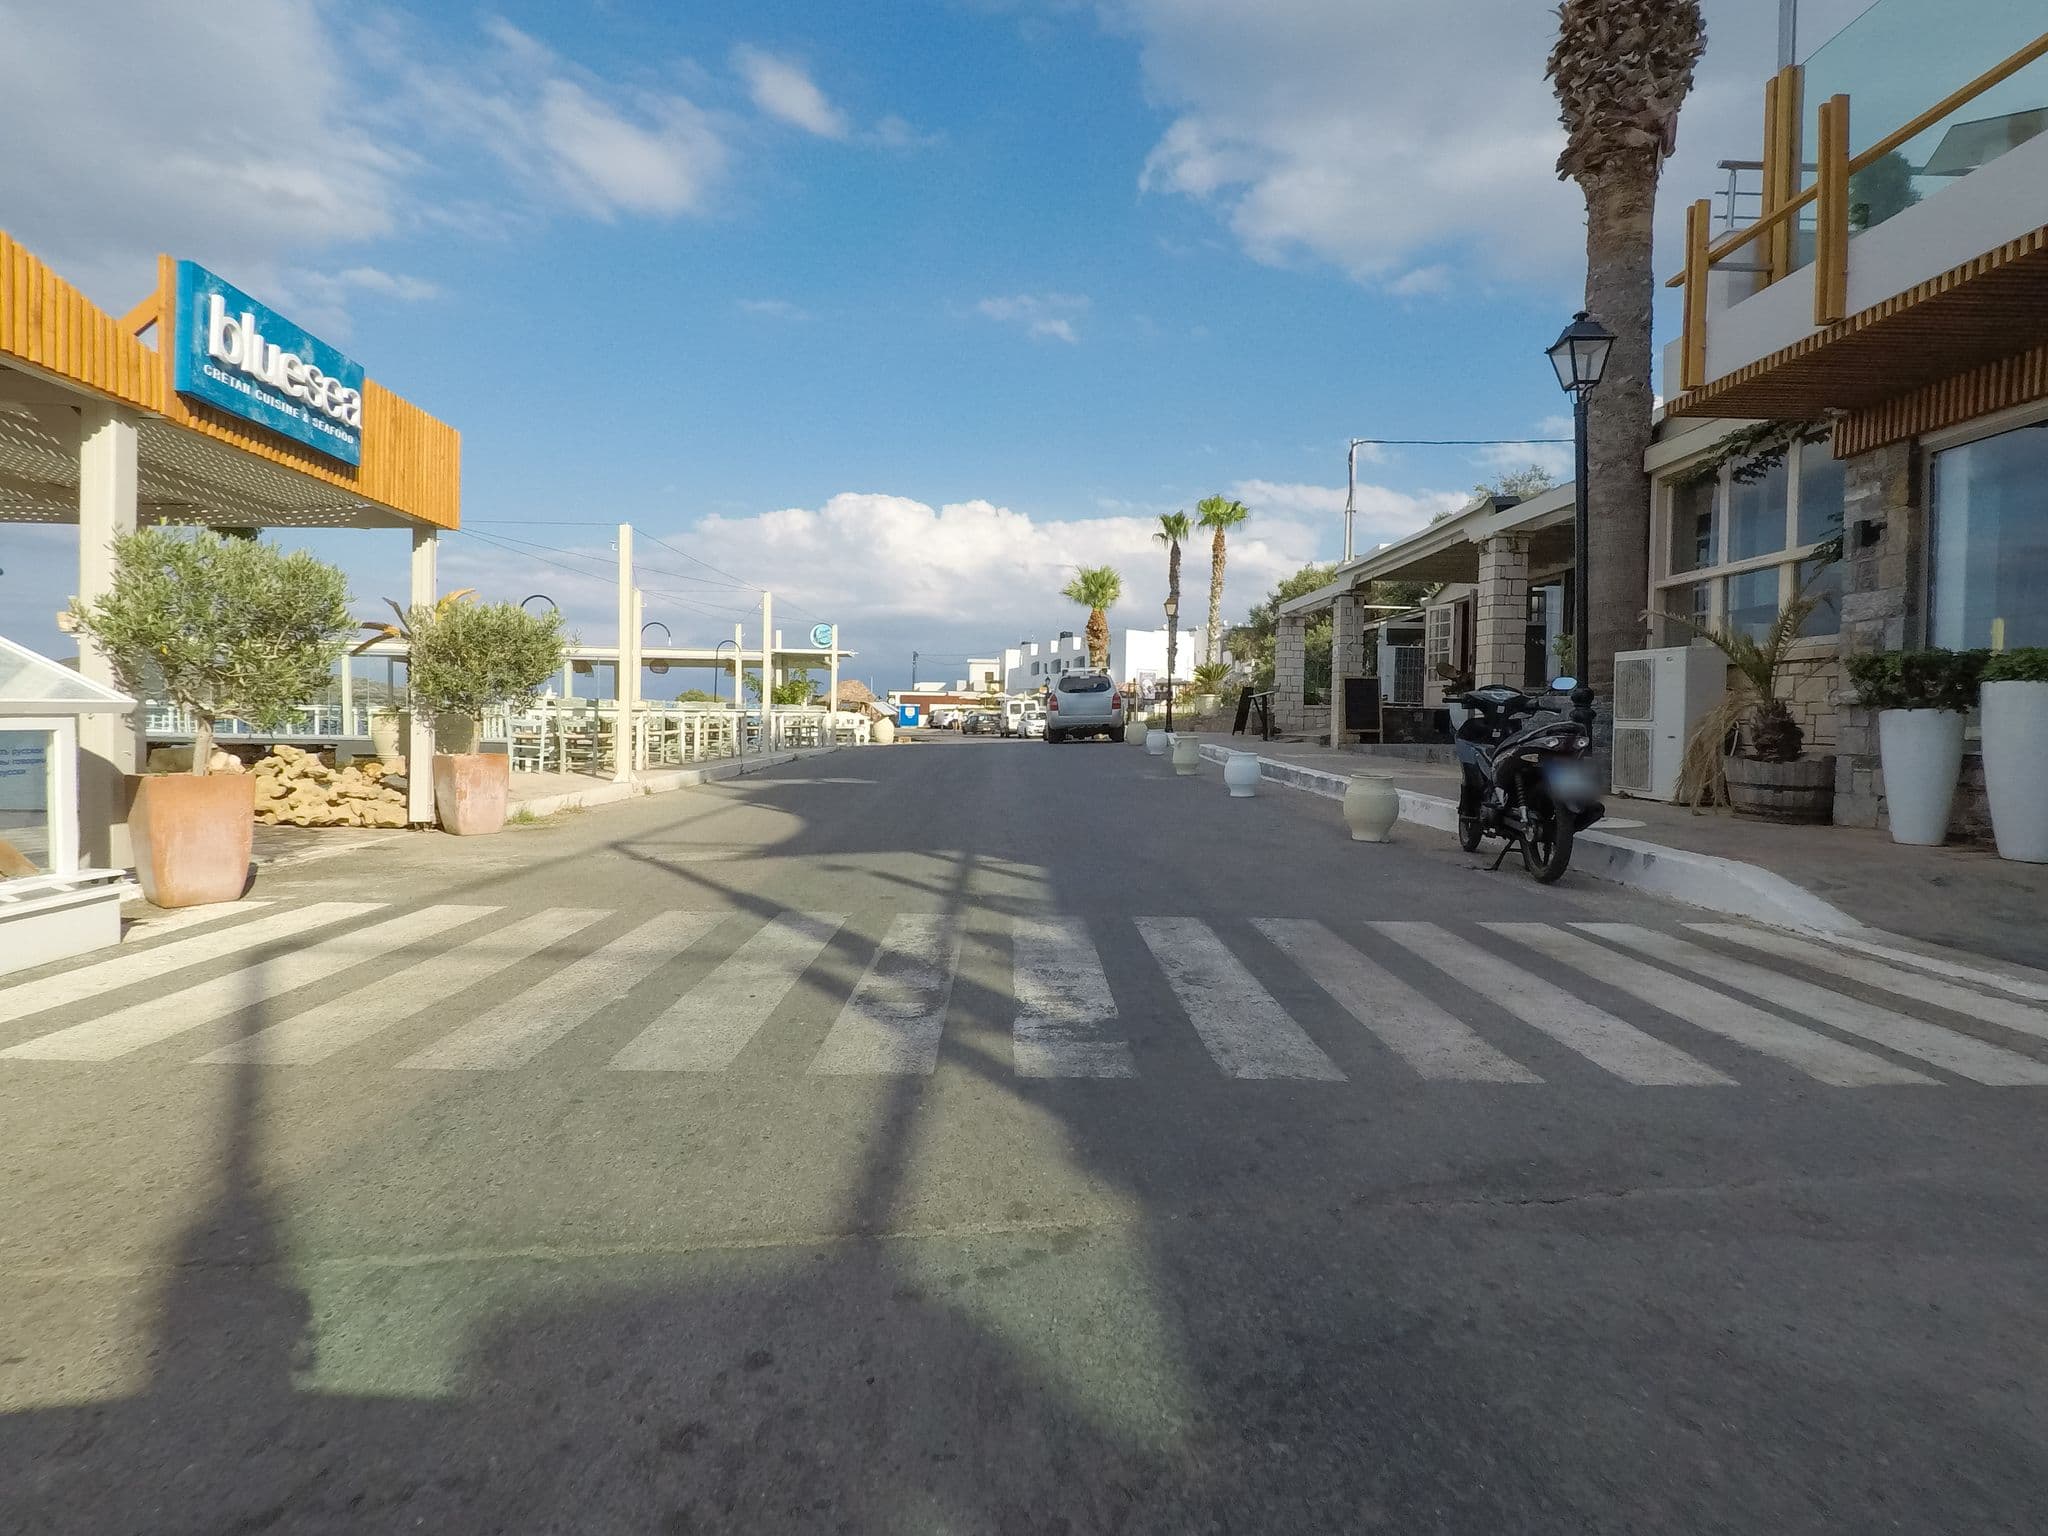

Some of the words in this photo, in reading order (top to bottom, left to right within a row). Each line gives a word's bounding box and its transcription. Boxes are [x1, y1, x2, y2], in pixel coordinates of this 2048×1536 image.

[203, 364, 250, 395] CRETAN
[255, 389, 300, 419] CUISINE
[302, 414, 310, 425] &
[311, 416, 354, 444] SEAFOOD
[208, 293, 362, 429] bluesea
